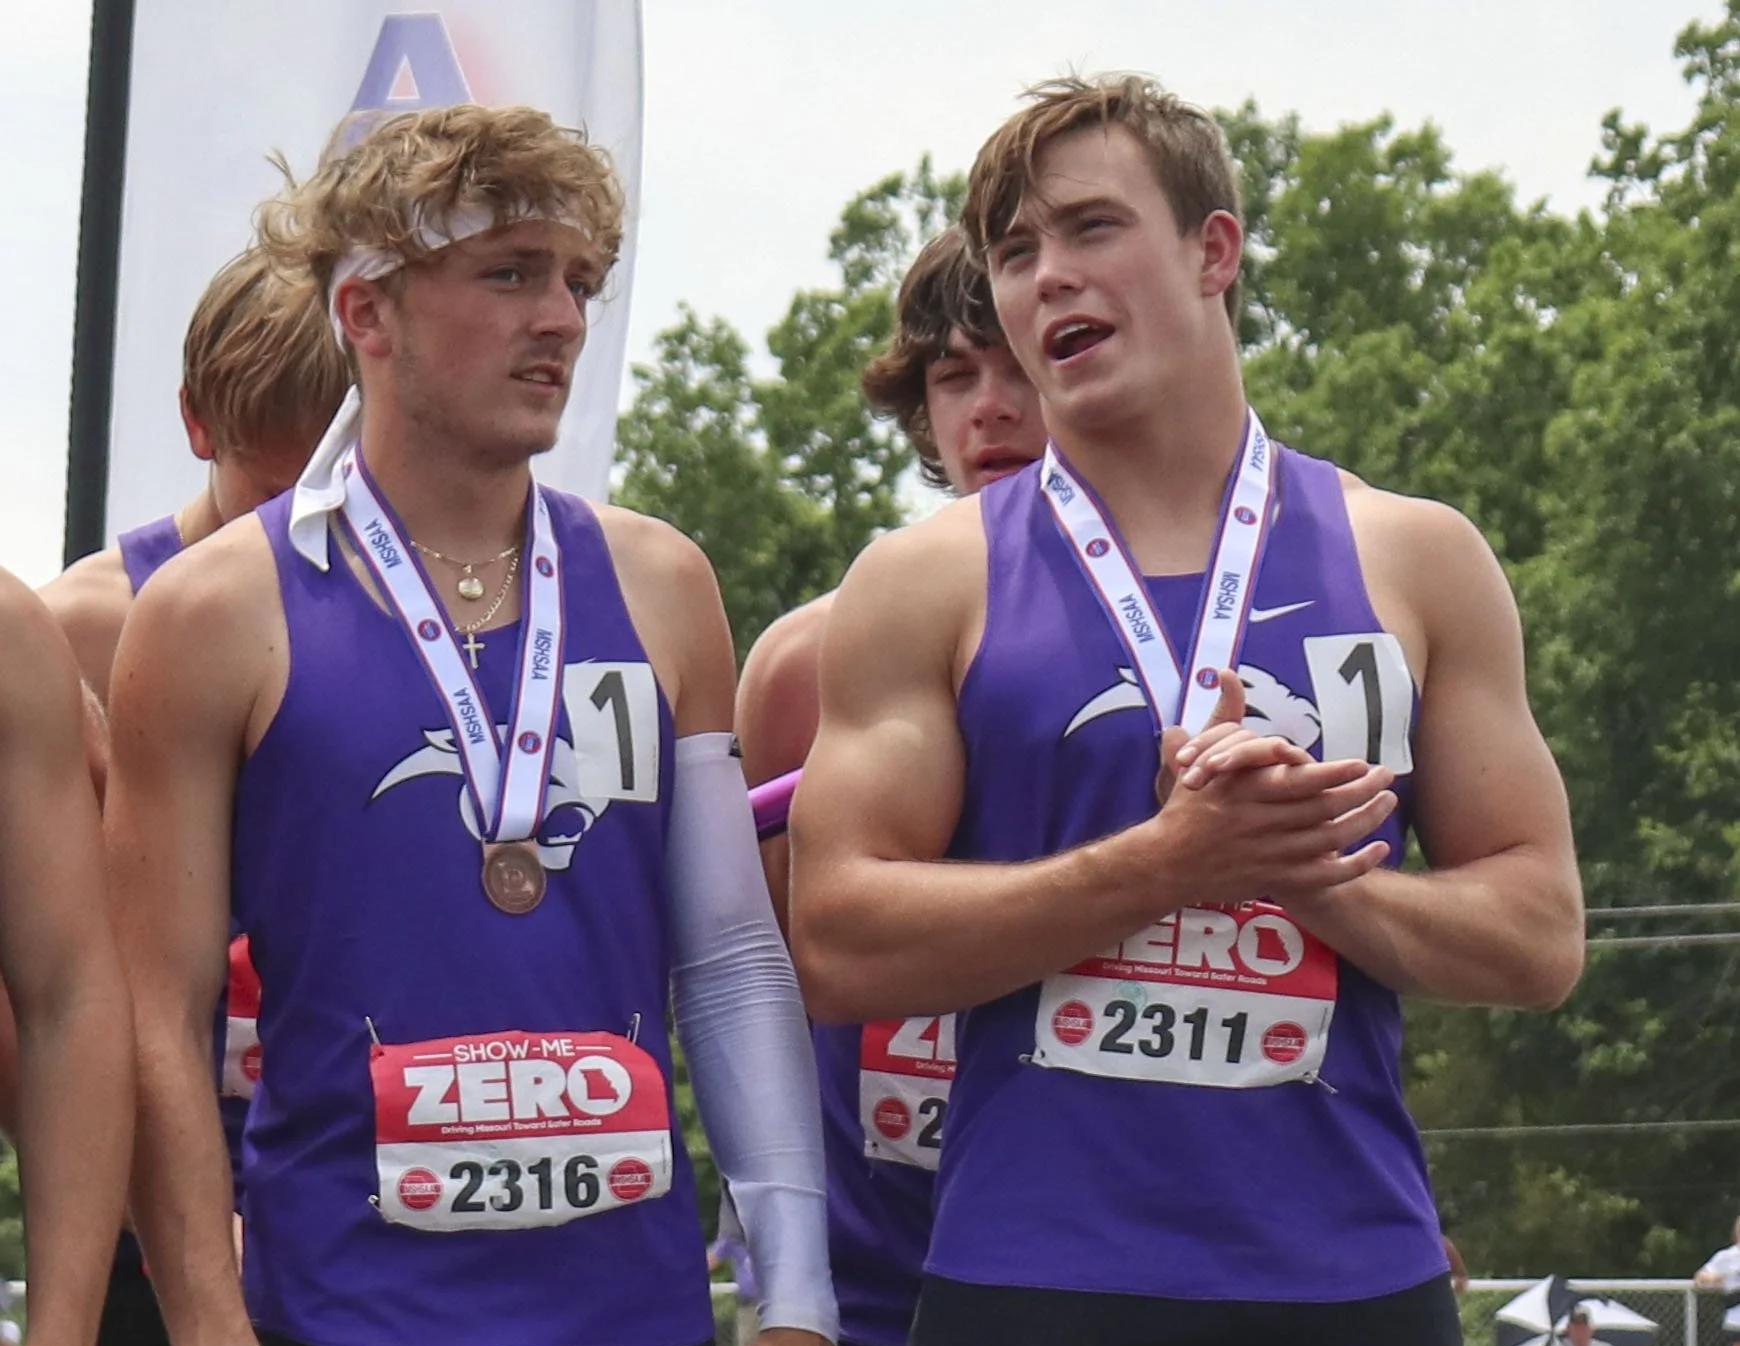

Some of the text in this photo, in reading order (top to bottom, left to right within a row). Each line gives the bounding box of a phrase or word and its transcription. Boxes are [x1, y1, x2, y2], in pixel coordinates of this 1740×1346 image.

[363, 517, 403, 569] MSHSAA
[1118, 593, 1156, 644] MSHSAA
[1212, 571, 1241, 620] MSHSAA
[531, 627, 553, 680] MSHSAA
[453, 686, 487, 745] MSHSAA
[589, 670, 635, 791] 1
[1338, 642, 1384, 766] 1
[1097, 909, 1305, 976] ERO
[1134, 963, 1173, 976] Missouri
[452, 1038, 576, 1063] SHOW-ME
[1099, 1000, 1249, 1064] 2311
[403, 1055, 633, 1126] ZERO
[441, 1125, 475, 1135] Driving
[475, 1122, 512, 1133] Missouri
[450, 1154, 601, 1213] 2316
